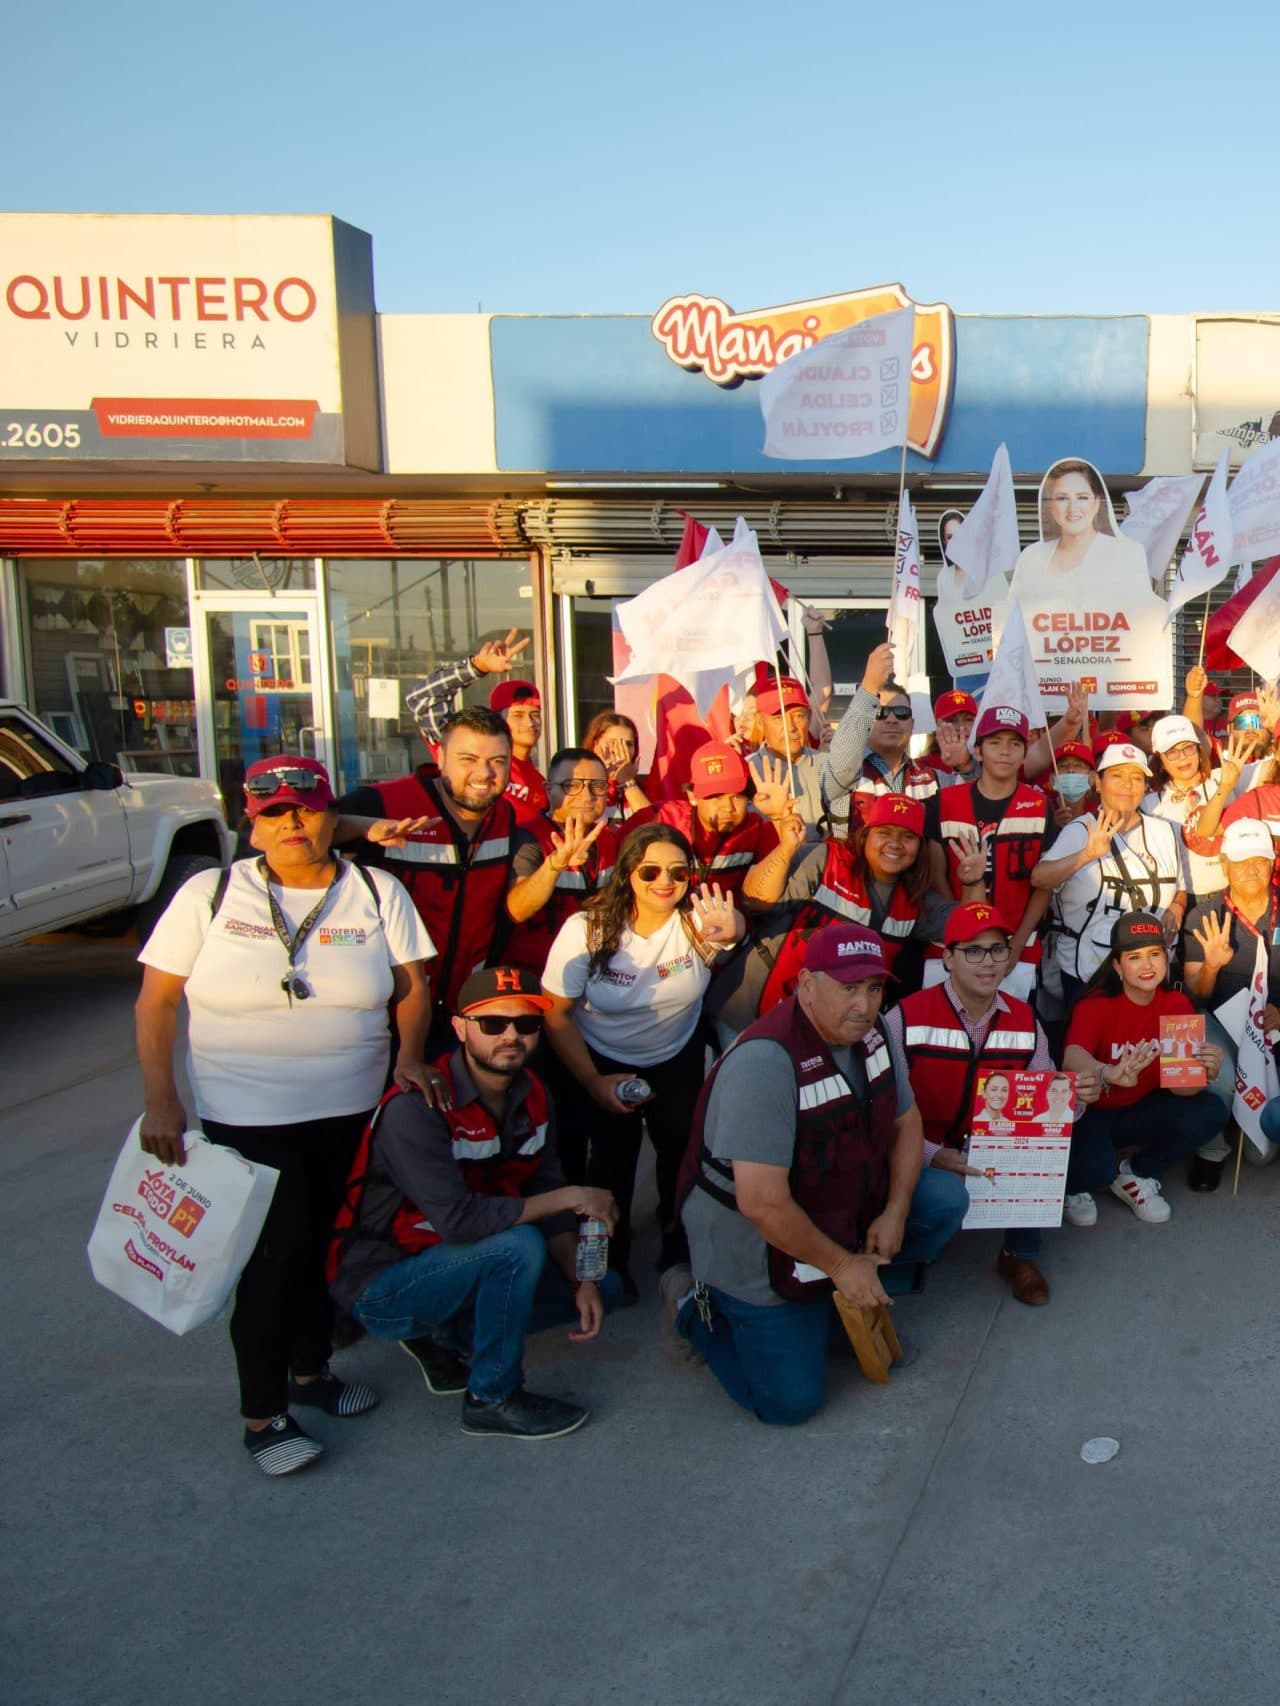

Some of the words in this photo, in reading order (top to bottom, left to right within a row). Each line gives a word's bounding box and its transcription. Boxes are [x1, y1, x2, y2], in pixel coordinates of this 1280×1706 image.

[6, 275, 317, 322] QUINTERO
[65, 331, 266, 350] VIDRIERA
[108, 415, 305, 428] VIDRIERAQUINTERO@HOTMAIL.COM
[955, 607, 992, 624] CELID
[1032, 612, 1130, 633] CELIDA
[963, 624, 992, 638] LÓPE
[1043, 633, 1121, 653] LÓPEZ
[1054, 657, 1113, 665] SENADORA
[1109, 684, 1136, 692] SOMOS
[893, 804, 909, 814] PT
[1131, 924, 1160, 935] CELIDA
[837, 941, 881, 953] SANTOS
[495, 969, 522, 991] H
[1016, 1097, 1033, 1109] PT
[1244, 1090, 1260, 1108] PT
[142, 1183, 168, 1215] TODO
[168, 1173, 176, 1182] 2
[175, 1178, 188, 1191] DE
[186, 1184, 211, 1209] JUNIO
[170, 1207, 197, 1234] PT
[147, 1231, 196, 1272] FROYLÁN
